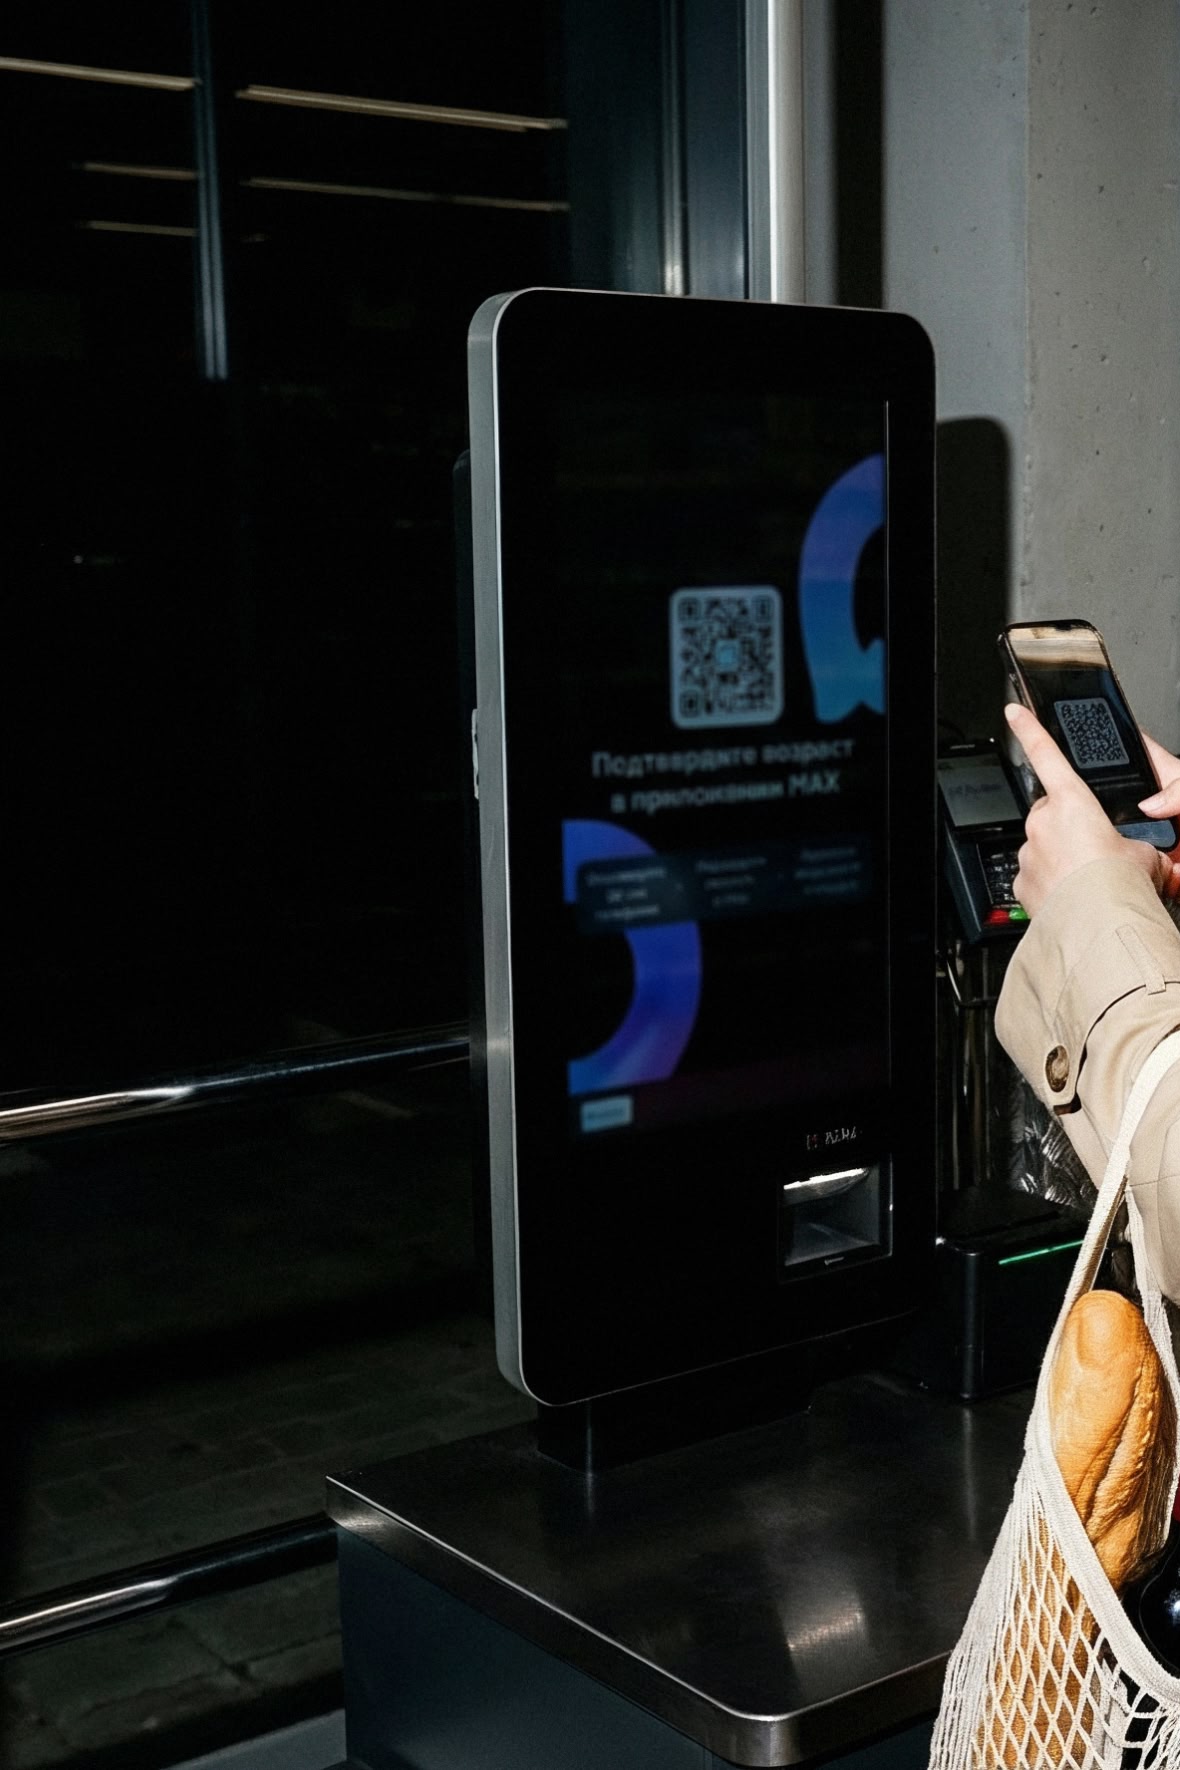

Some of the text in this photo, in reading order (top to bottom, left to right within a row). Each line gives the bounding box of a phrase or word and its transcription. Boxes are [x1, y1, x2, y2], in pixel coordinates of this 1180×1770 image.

[591, 738, 855, 778] Подтвердите возраст
[610, 770, 840, 815] в приложении MAX
